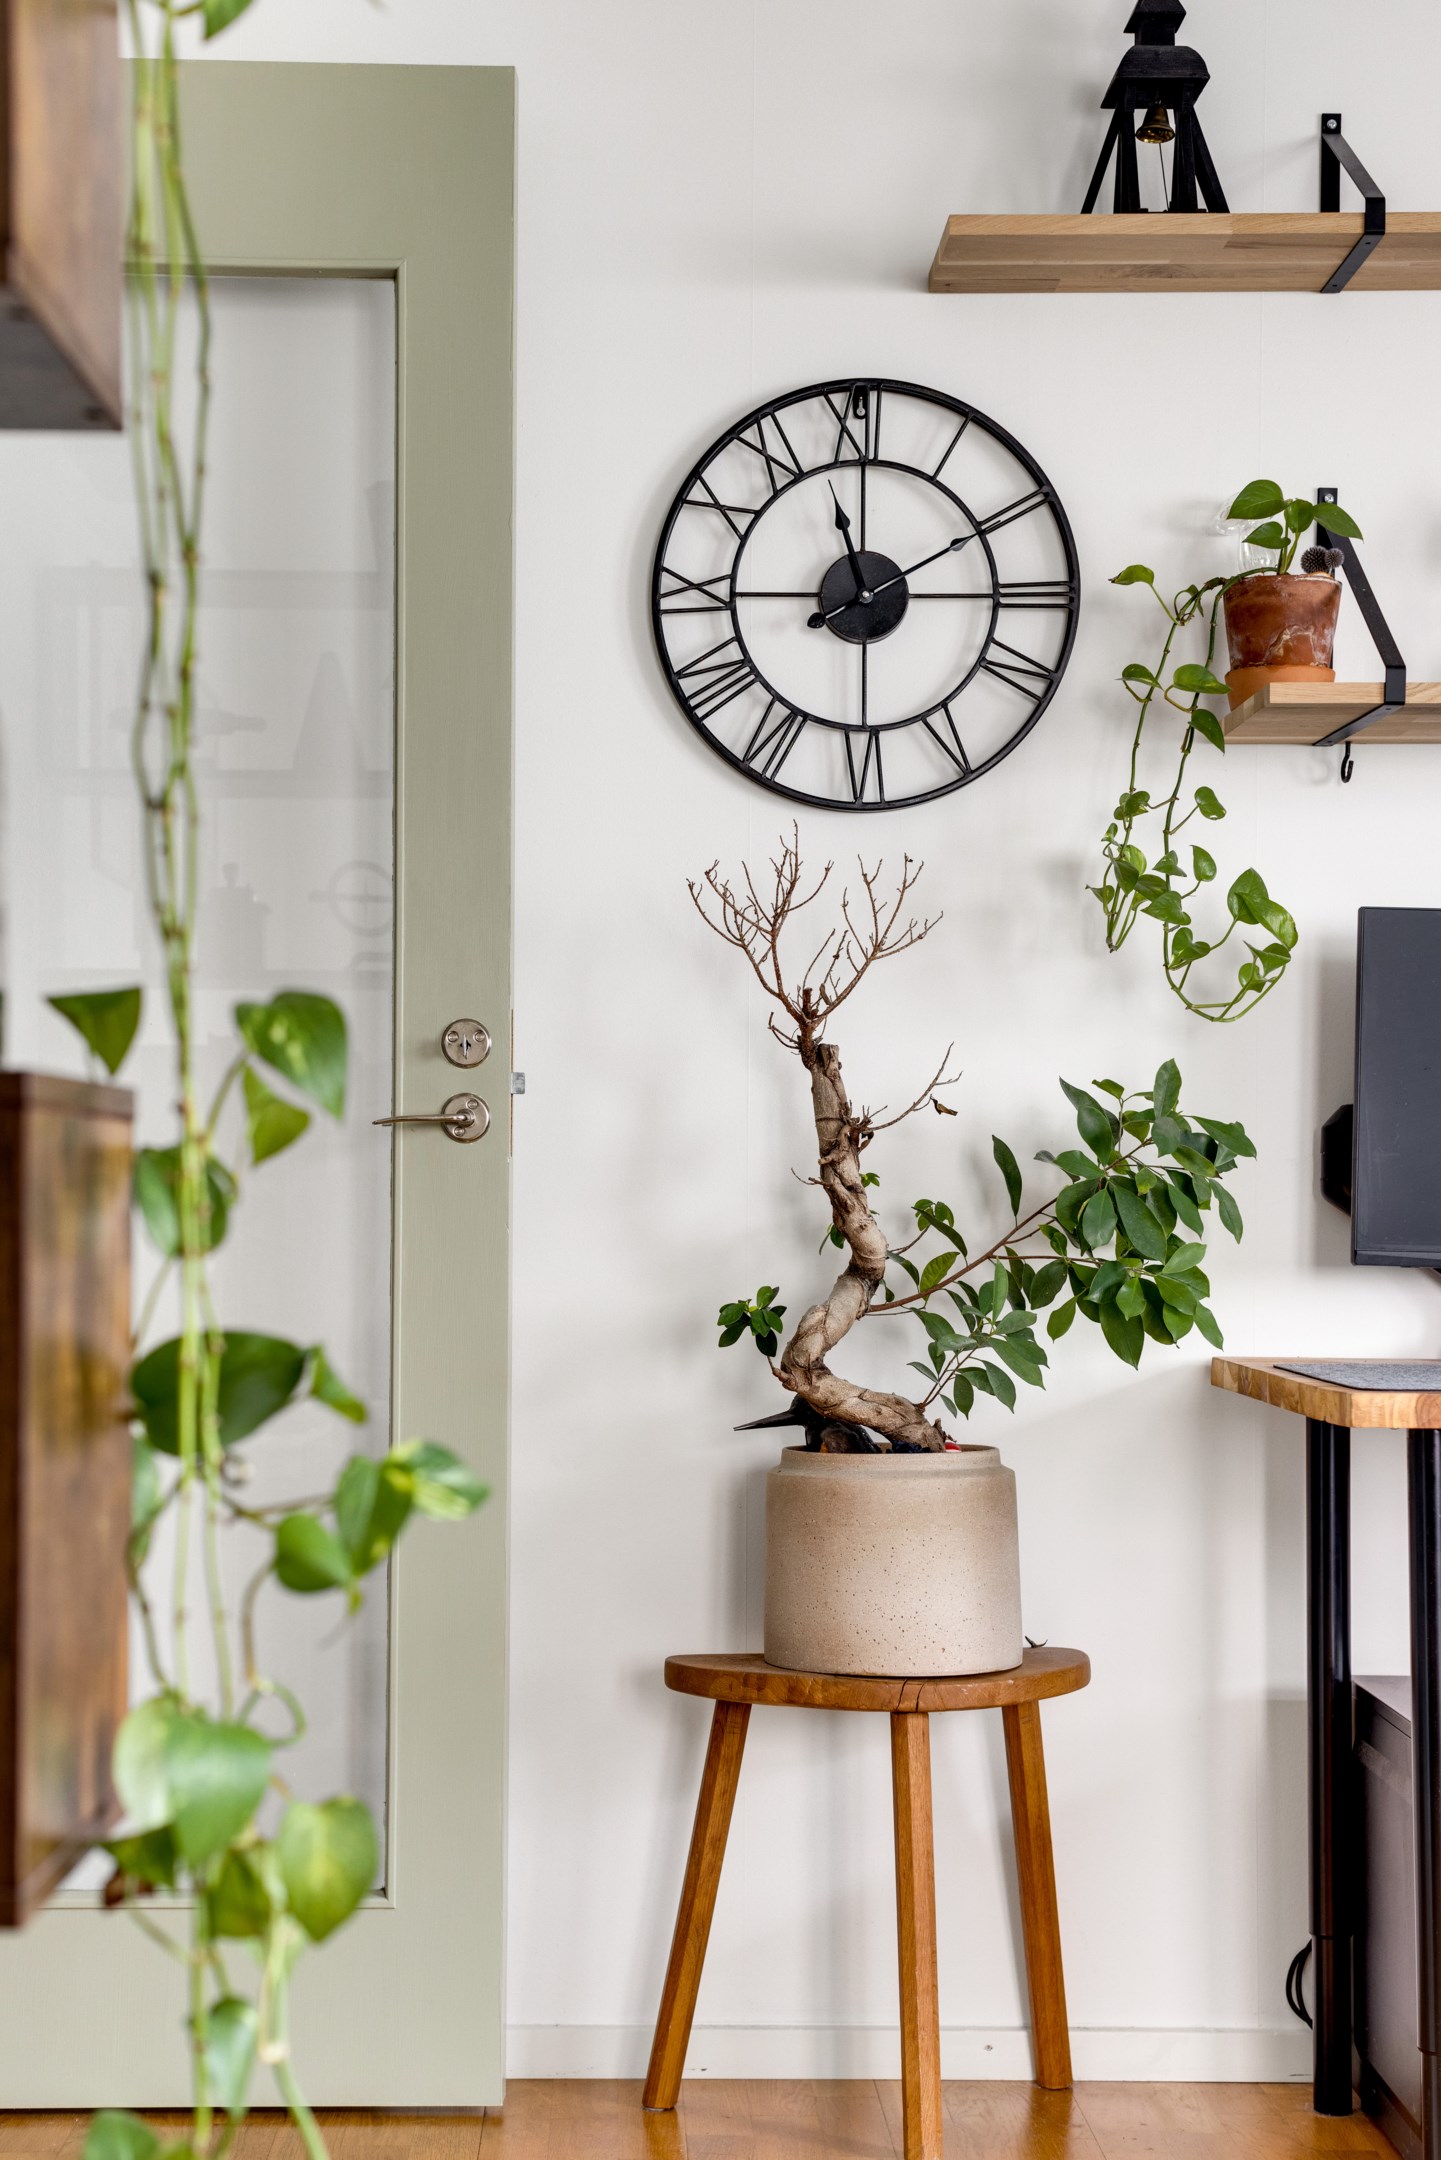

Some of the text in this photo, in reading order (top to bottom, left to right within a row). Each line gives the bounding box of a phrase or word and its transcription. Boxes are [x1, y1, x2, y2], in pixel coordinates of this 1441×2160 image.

[732, 410, 806, 497] XI
[822, 386, 882, 461] XII
[931, 413, 973, 481] I
[681, 474, 760, 542] X
[978, 486, 1051, 535] II
[658, 565, 733, 615] IX
[998, 581, 1072, 609] III
[673, 635, 761, 724] VIII
[979, 636, 1054, 703] IV
[743, 696, 808, 782] VII
[844, 728, 885, 803] VI
[921, 701, 973, 775] V
